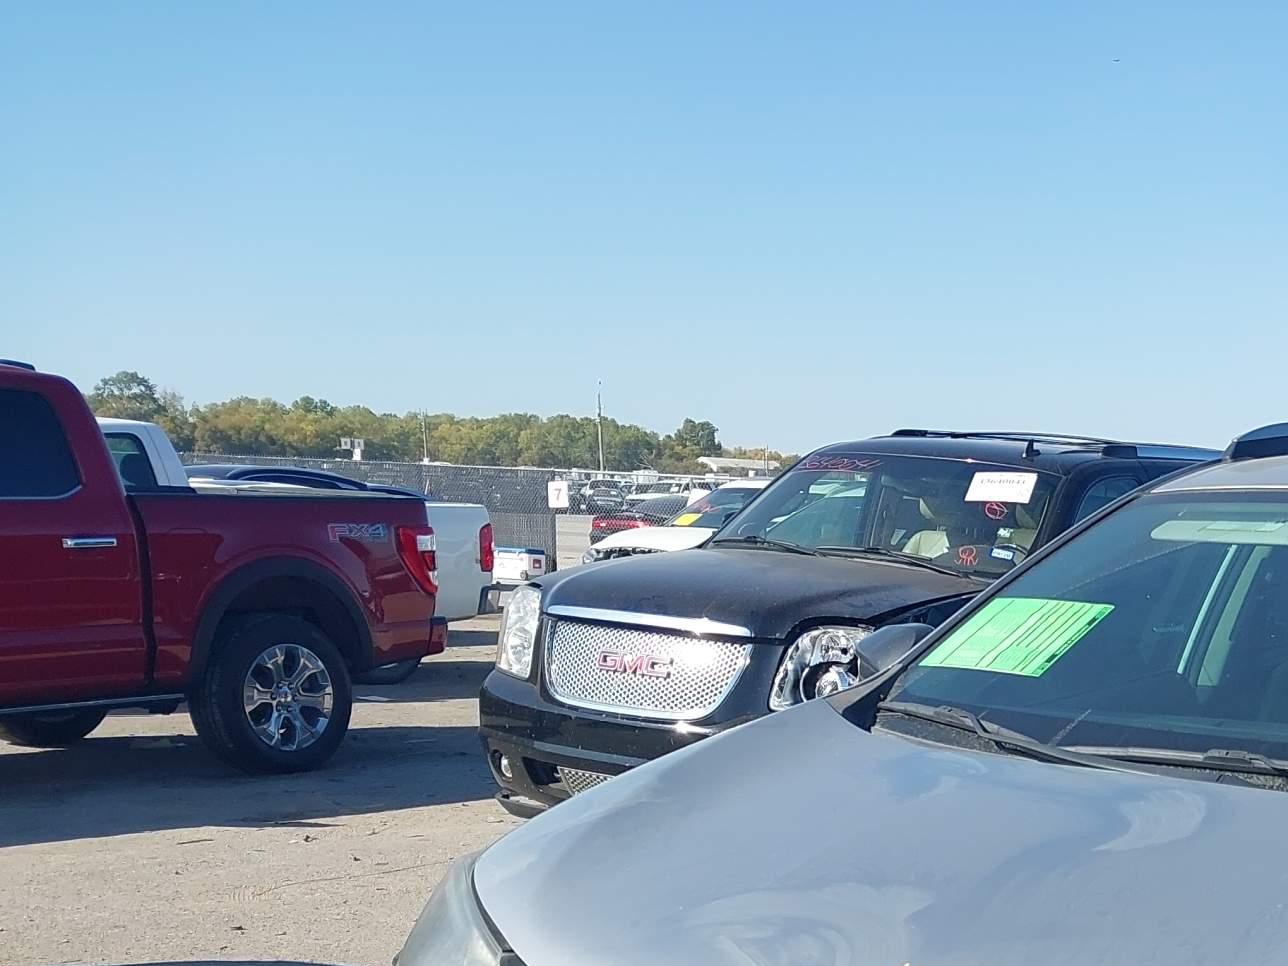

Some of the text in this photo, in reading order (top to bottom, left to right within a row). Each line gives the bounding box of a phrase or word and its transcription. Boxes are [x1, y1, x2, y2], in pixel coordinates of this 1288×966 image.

[554, 488, 562, 501] 7
[327, 523, 385, 543] FX4
[598, 651, 673, 678] GMC
